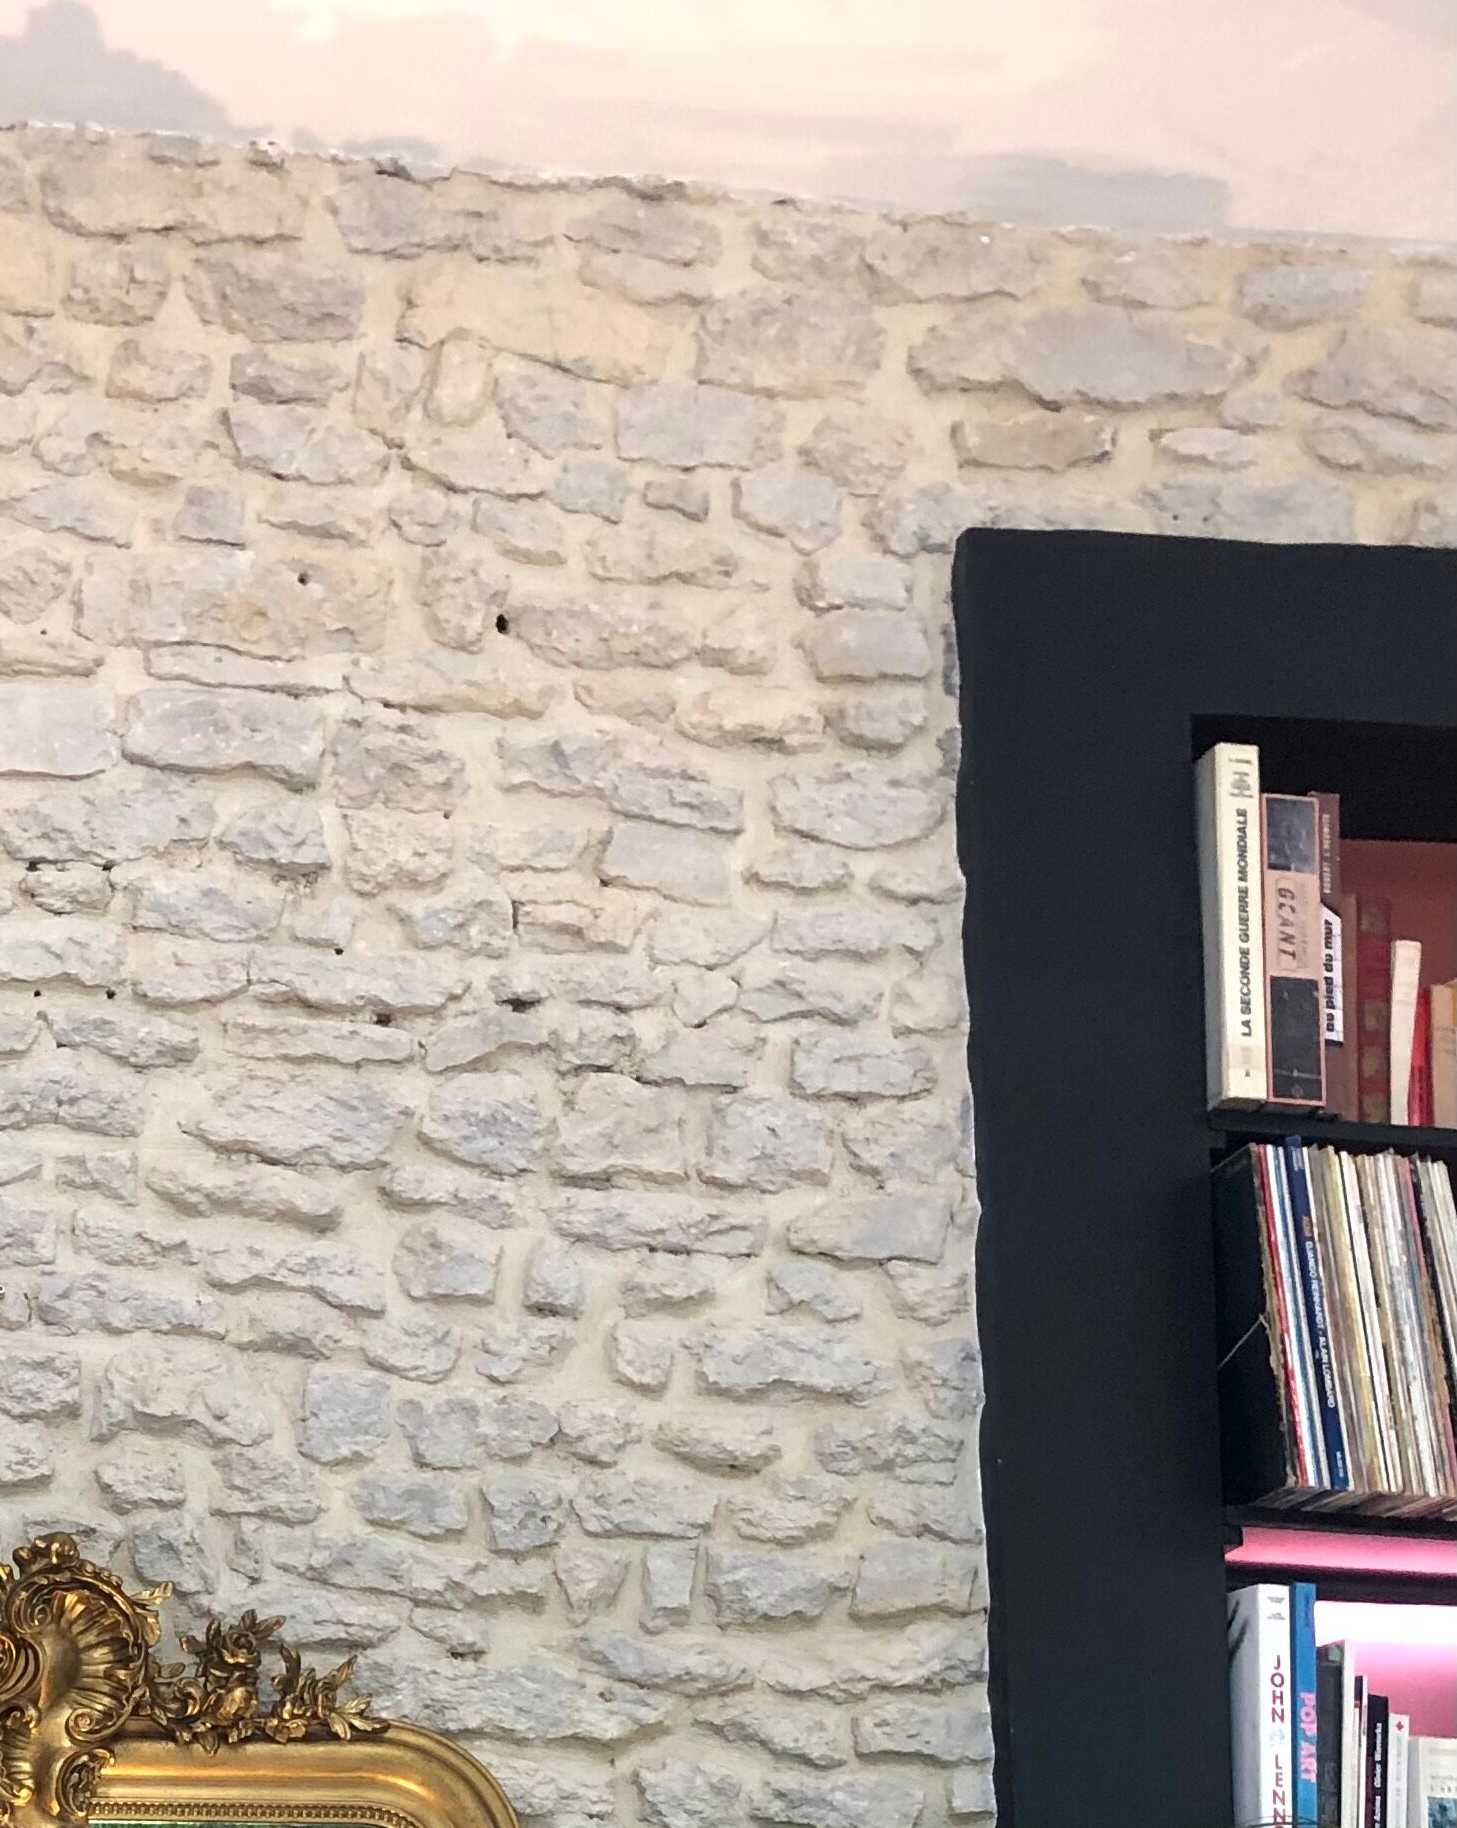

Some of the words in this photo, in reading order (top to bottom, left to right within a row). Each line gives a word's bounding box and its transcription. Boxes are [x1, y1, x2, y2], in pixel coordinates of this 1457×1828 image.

[1235, 807, 1249, 883] MONDIALE
[1237, 885, 1250, 944] GUERRE
[1323, 918, 1334, 950] mur
[1239, 946, 1252, 1015] SECONDE
[1323, 952, 1334, 973] du
[1323, 975, 1336, 1010] pied
[1241, 1018, 1252, 1037] LA
[1324, 1011, 1335, 1033] au
[1270, 1654, 1285, 1724] JOHN
[1299, 1691, 1317, 1737] POP
[1300, 1741, 1318, 1783] ART
